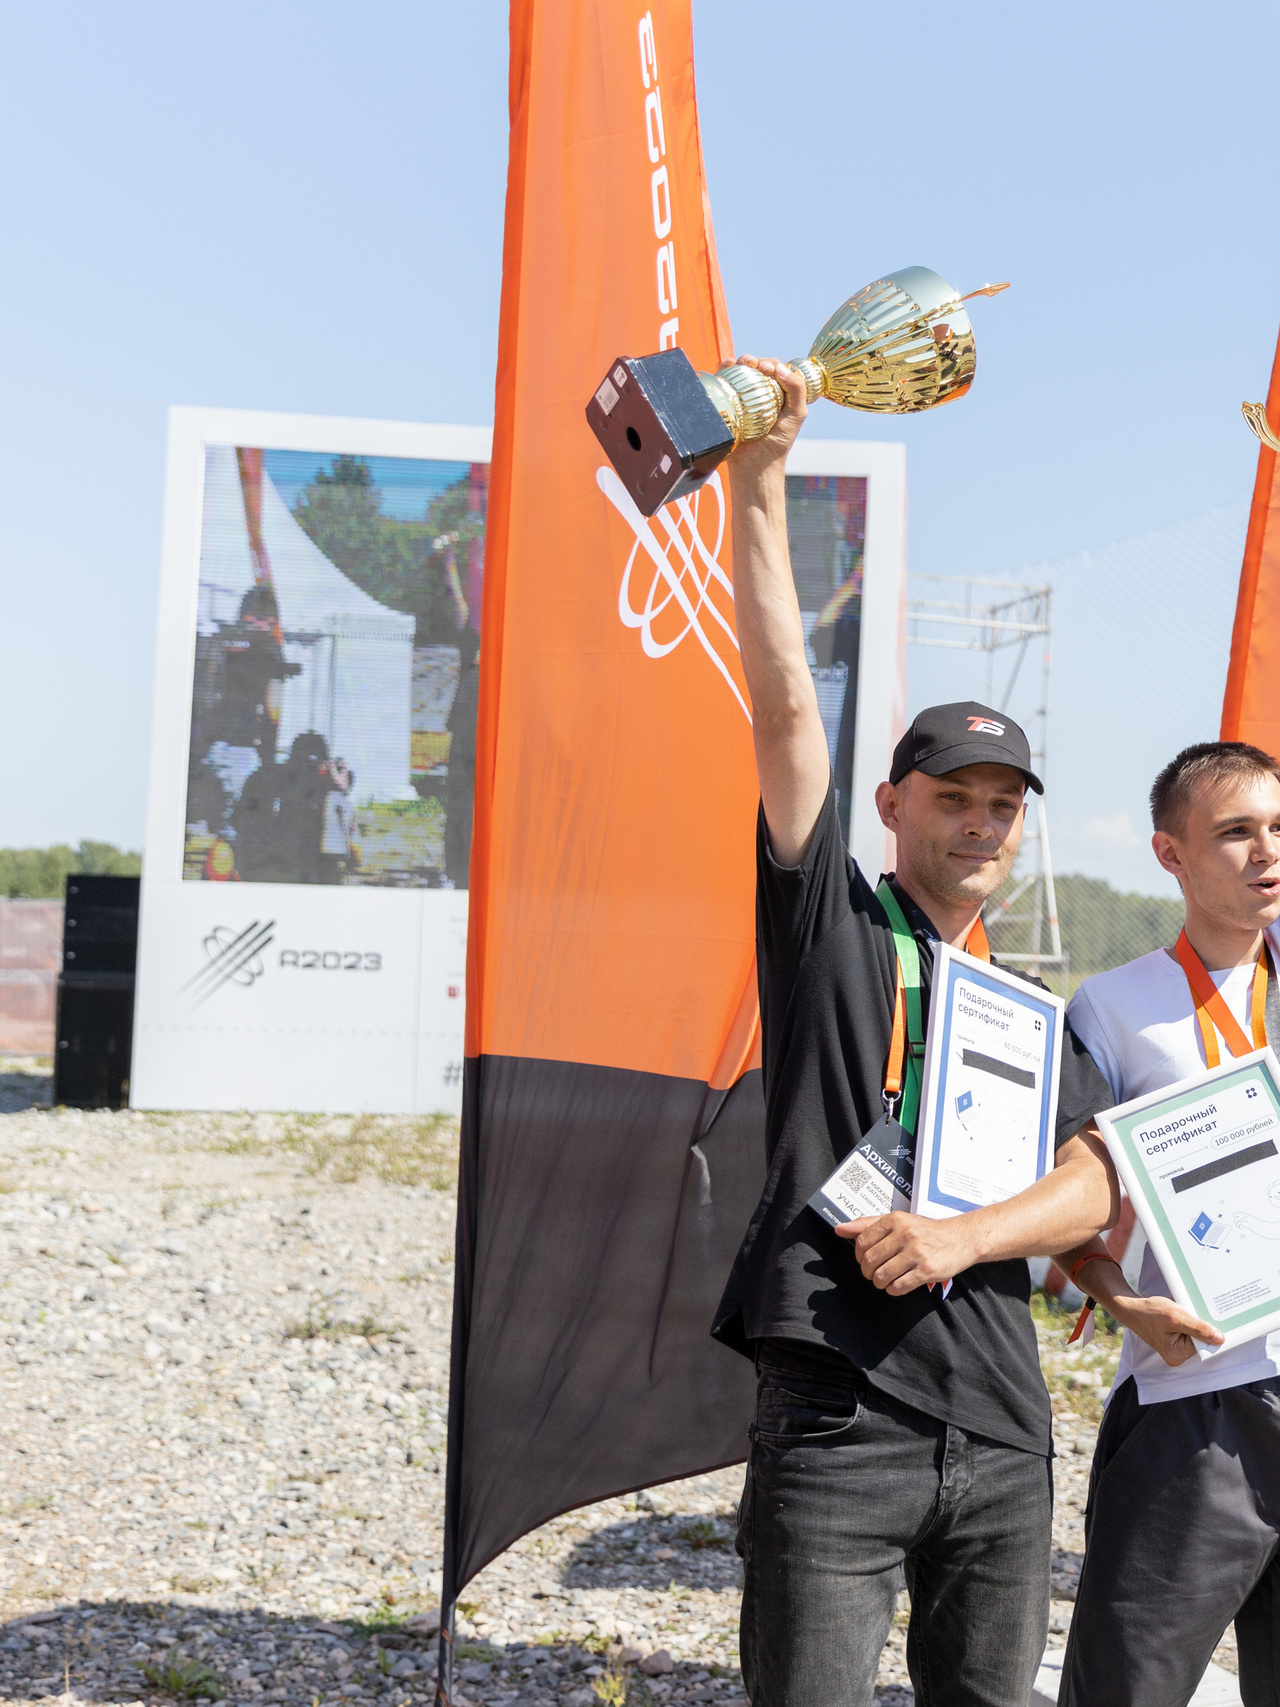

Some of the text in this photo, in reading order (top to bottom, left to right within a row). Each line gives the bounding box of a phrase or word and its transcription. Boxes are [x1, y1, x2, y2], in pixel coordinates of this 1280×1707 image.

[279, 949, 383, 971] R2023
[958, 1003, 1010, 1031] сертификат
[960, 987, 1014, 1019] Подарочный
[1139, 1104, 1218, 1142] Подарочный
[1146, 1120, 1218, 1155] сертификат
[1215, 1118, 1274, 1147] 100 000 рублей
